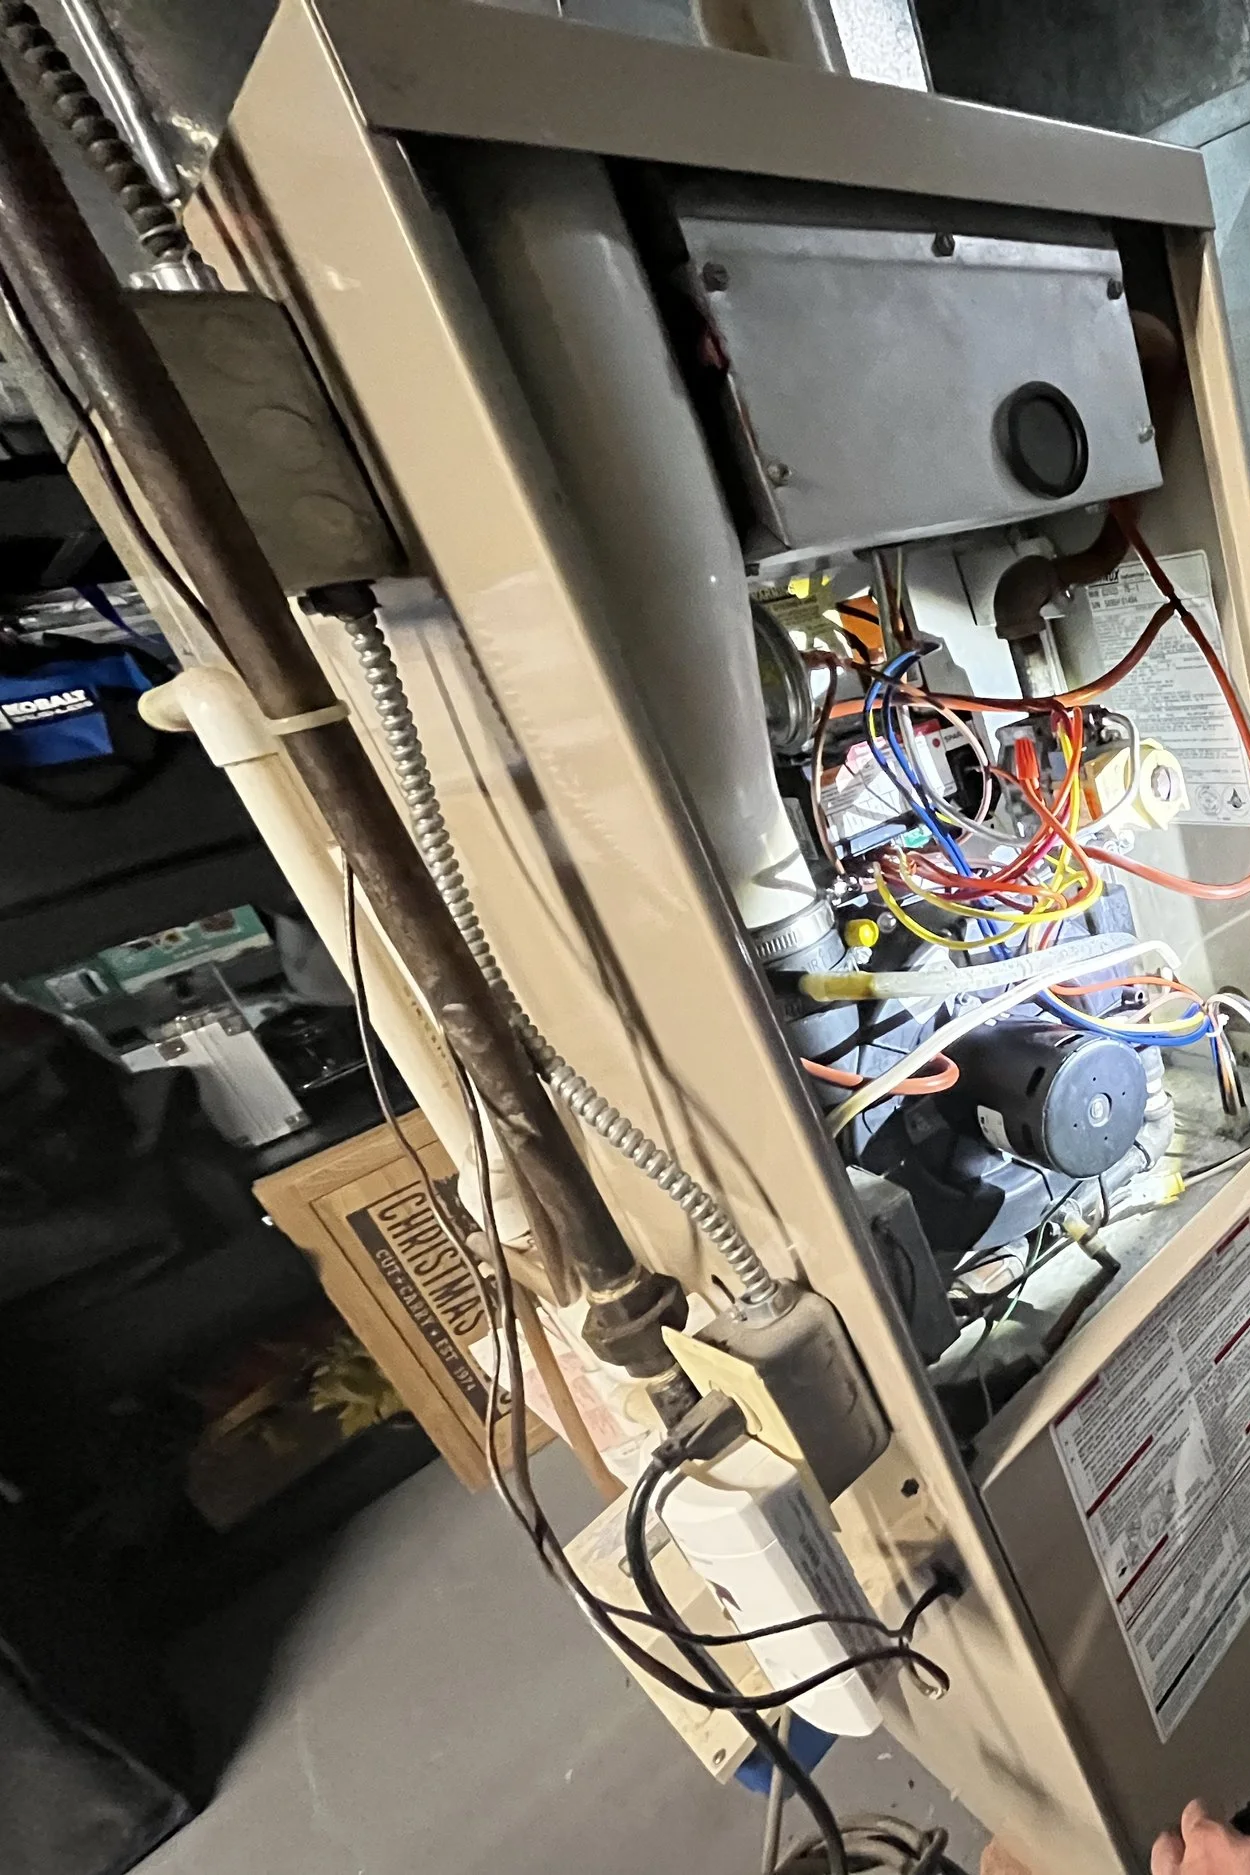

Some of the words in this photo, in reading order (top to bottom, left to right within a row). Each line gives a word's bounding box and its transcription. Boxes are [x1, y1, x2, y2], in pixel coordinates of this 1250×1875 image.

[1, 690, 86, 717] KOBALT
[375, 1249, 401, 1278] CUT
[399, 1284, 435, 1327] CARRY
[434, 1335, 459, 1361] EST
[453, 1366, 477, 1392] 1974
[378, 1192, 485, 1336] CHRISTMAS
